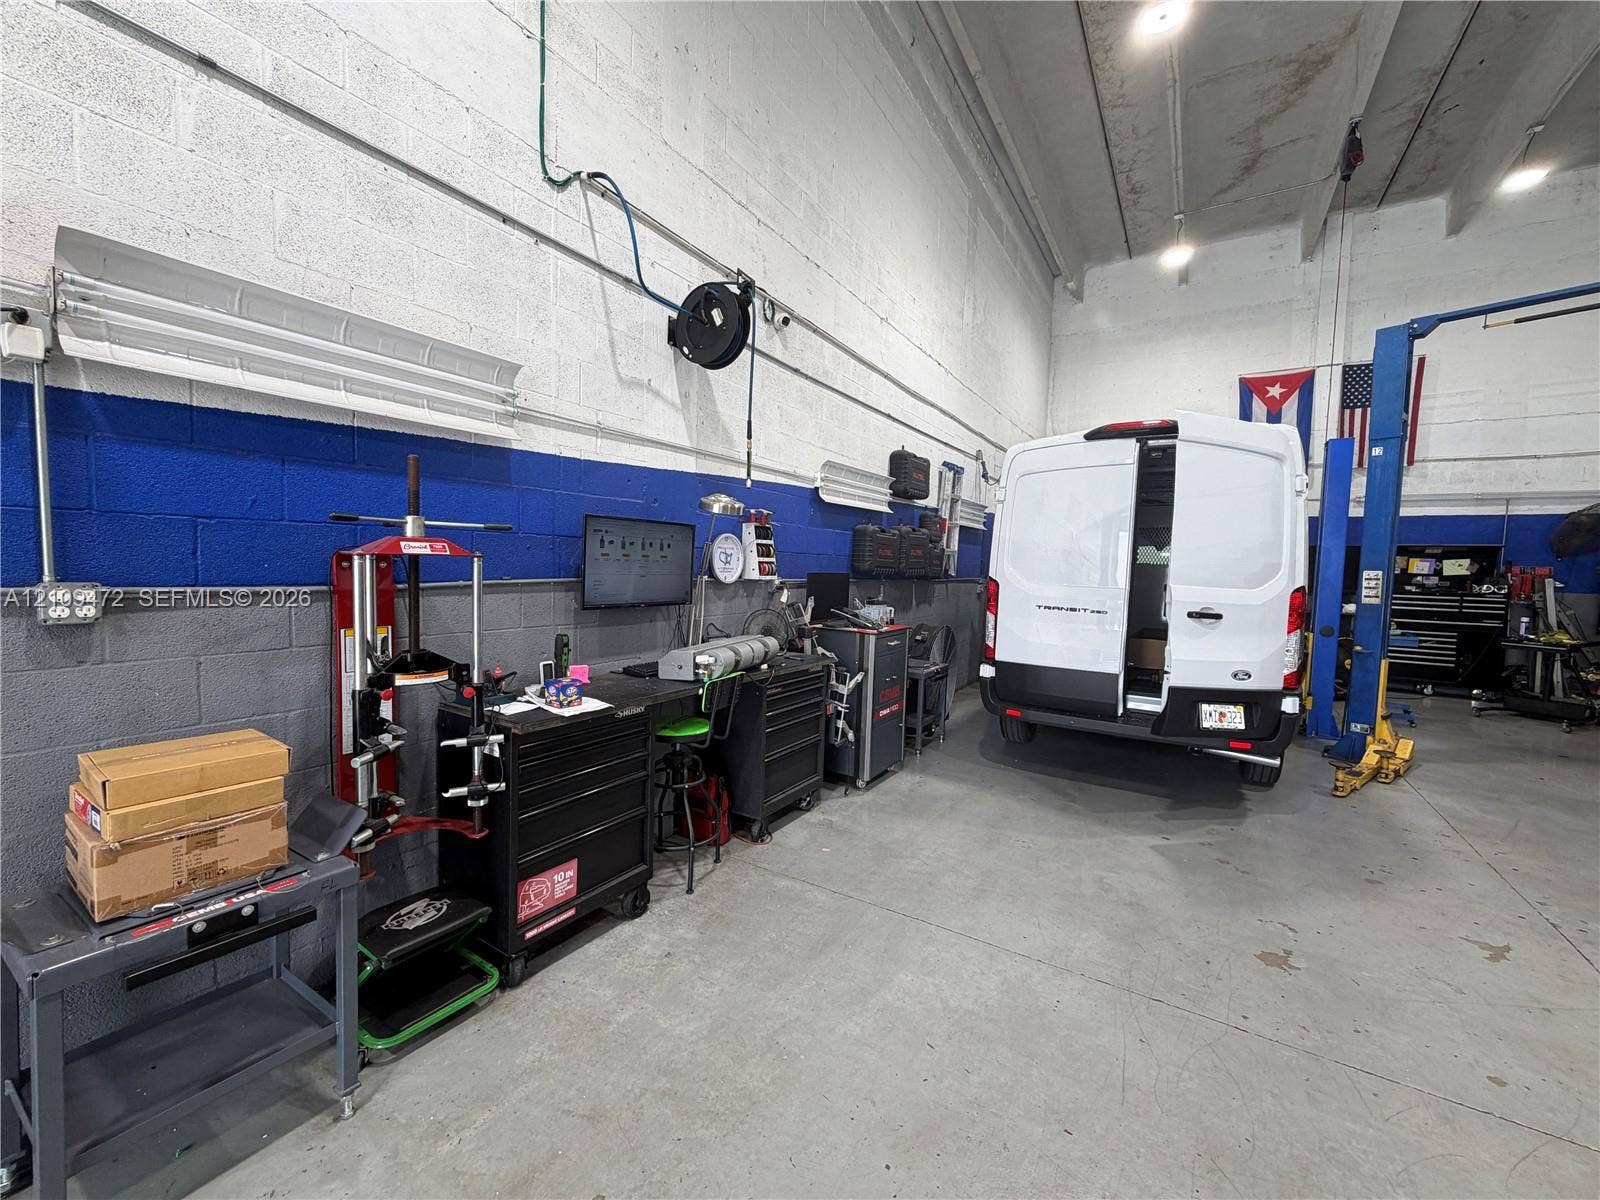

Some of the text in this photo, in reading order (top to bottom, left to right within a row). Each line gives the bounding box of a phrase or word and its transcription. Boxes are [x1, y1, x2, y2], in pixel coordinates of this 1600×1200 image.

[1035, 604, 1089, 613] TRANSIT
[553, 869, 574, 883] 10 IN
[231, 888, 267, 903] USA
